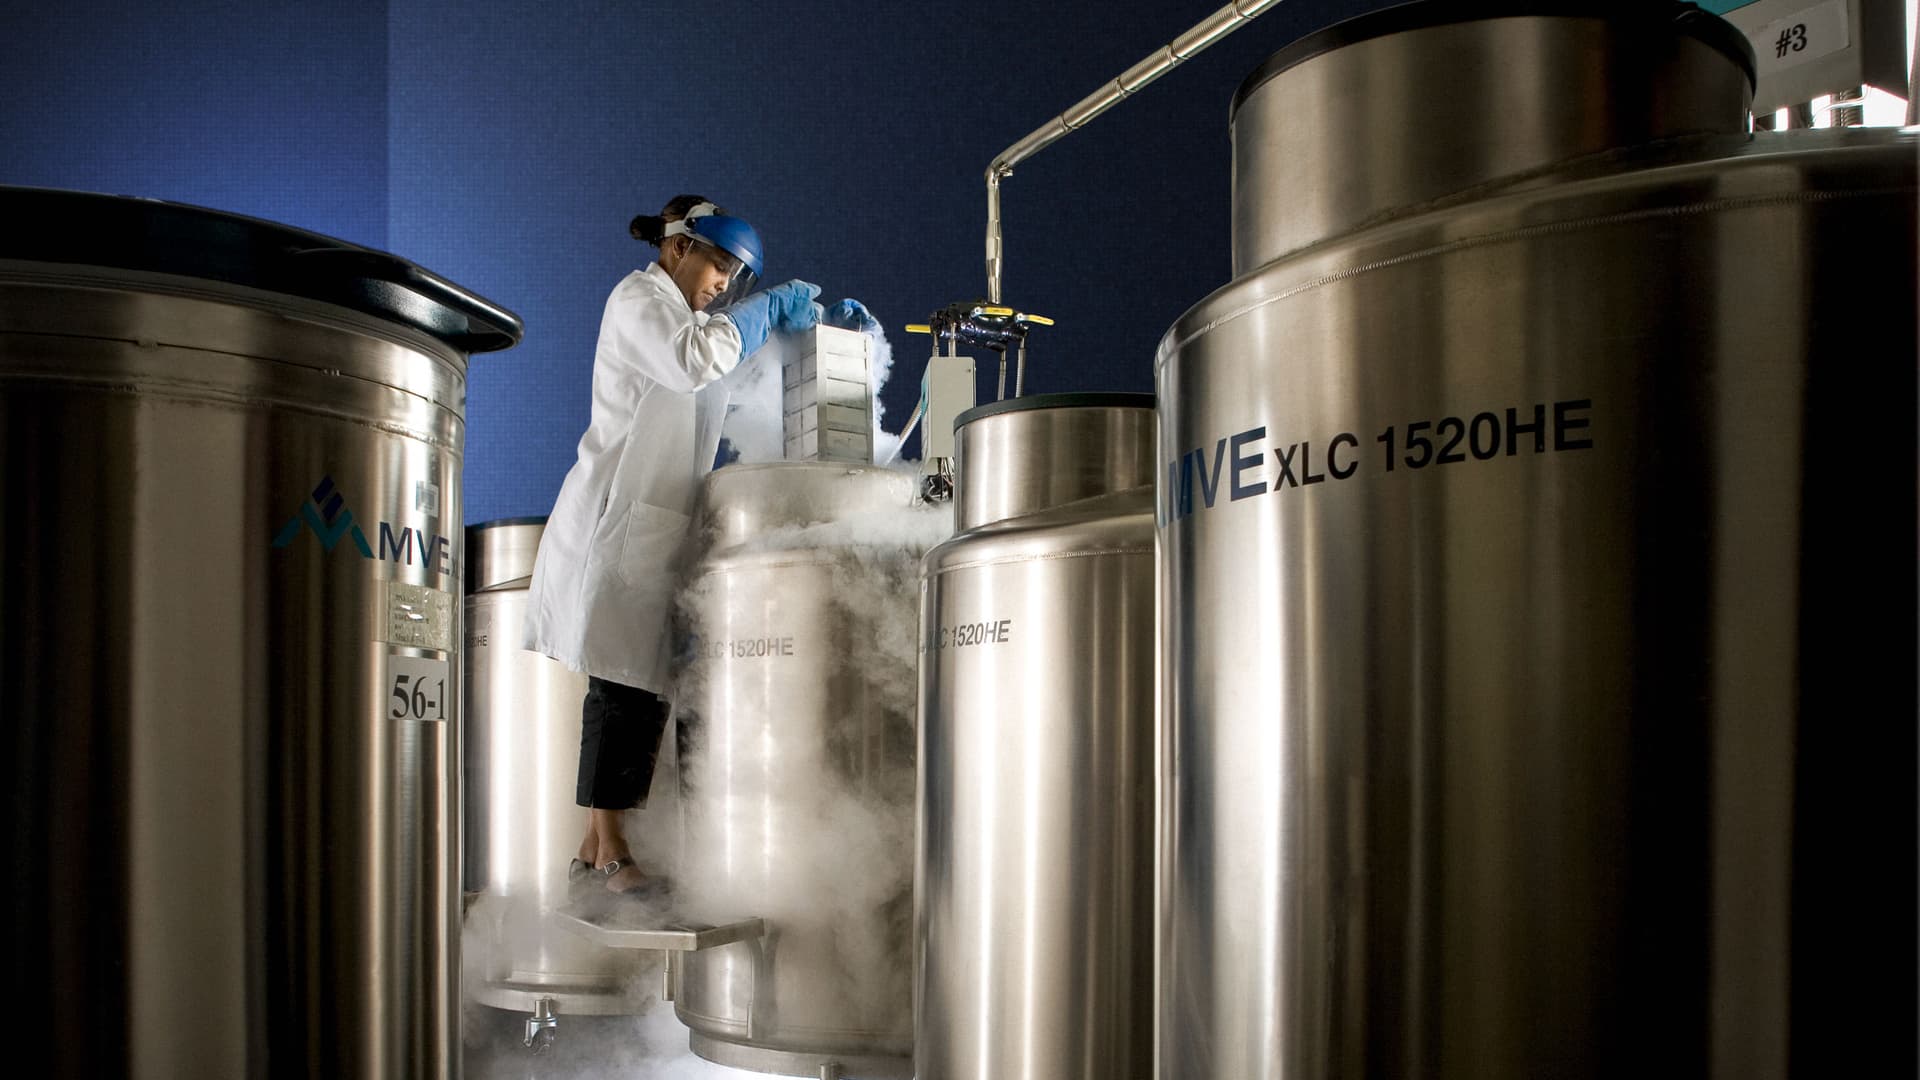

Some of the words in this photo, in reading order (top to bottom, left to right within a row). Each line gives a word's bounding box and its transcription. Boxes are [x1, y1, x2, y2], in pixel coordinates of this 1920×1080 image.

[1775, 23, 1808, 59] #3
[1168, 426, 1268, 523] MVE
[1273, 432, 1359, 493] XLC
[1376, 399, 1594, 473] 1520HE
[378, 521, 450, 576] MVE
[729, 637, 794, 658] 1520HE
[951, 619, 1012, 648] 1520HE
[391, 674, 447, 720] 56-1
